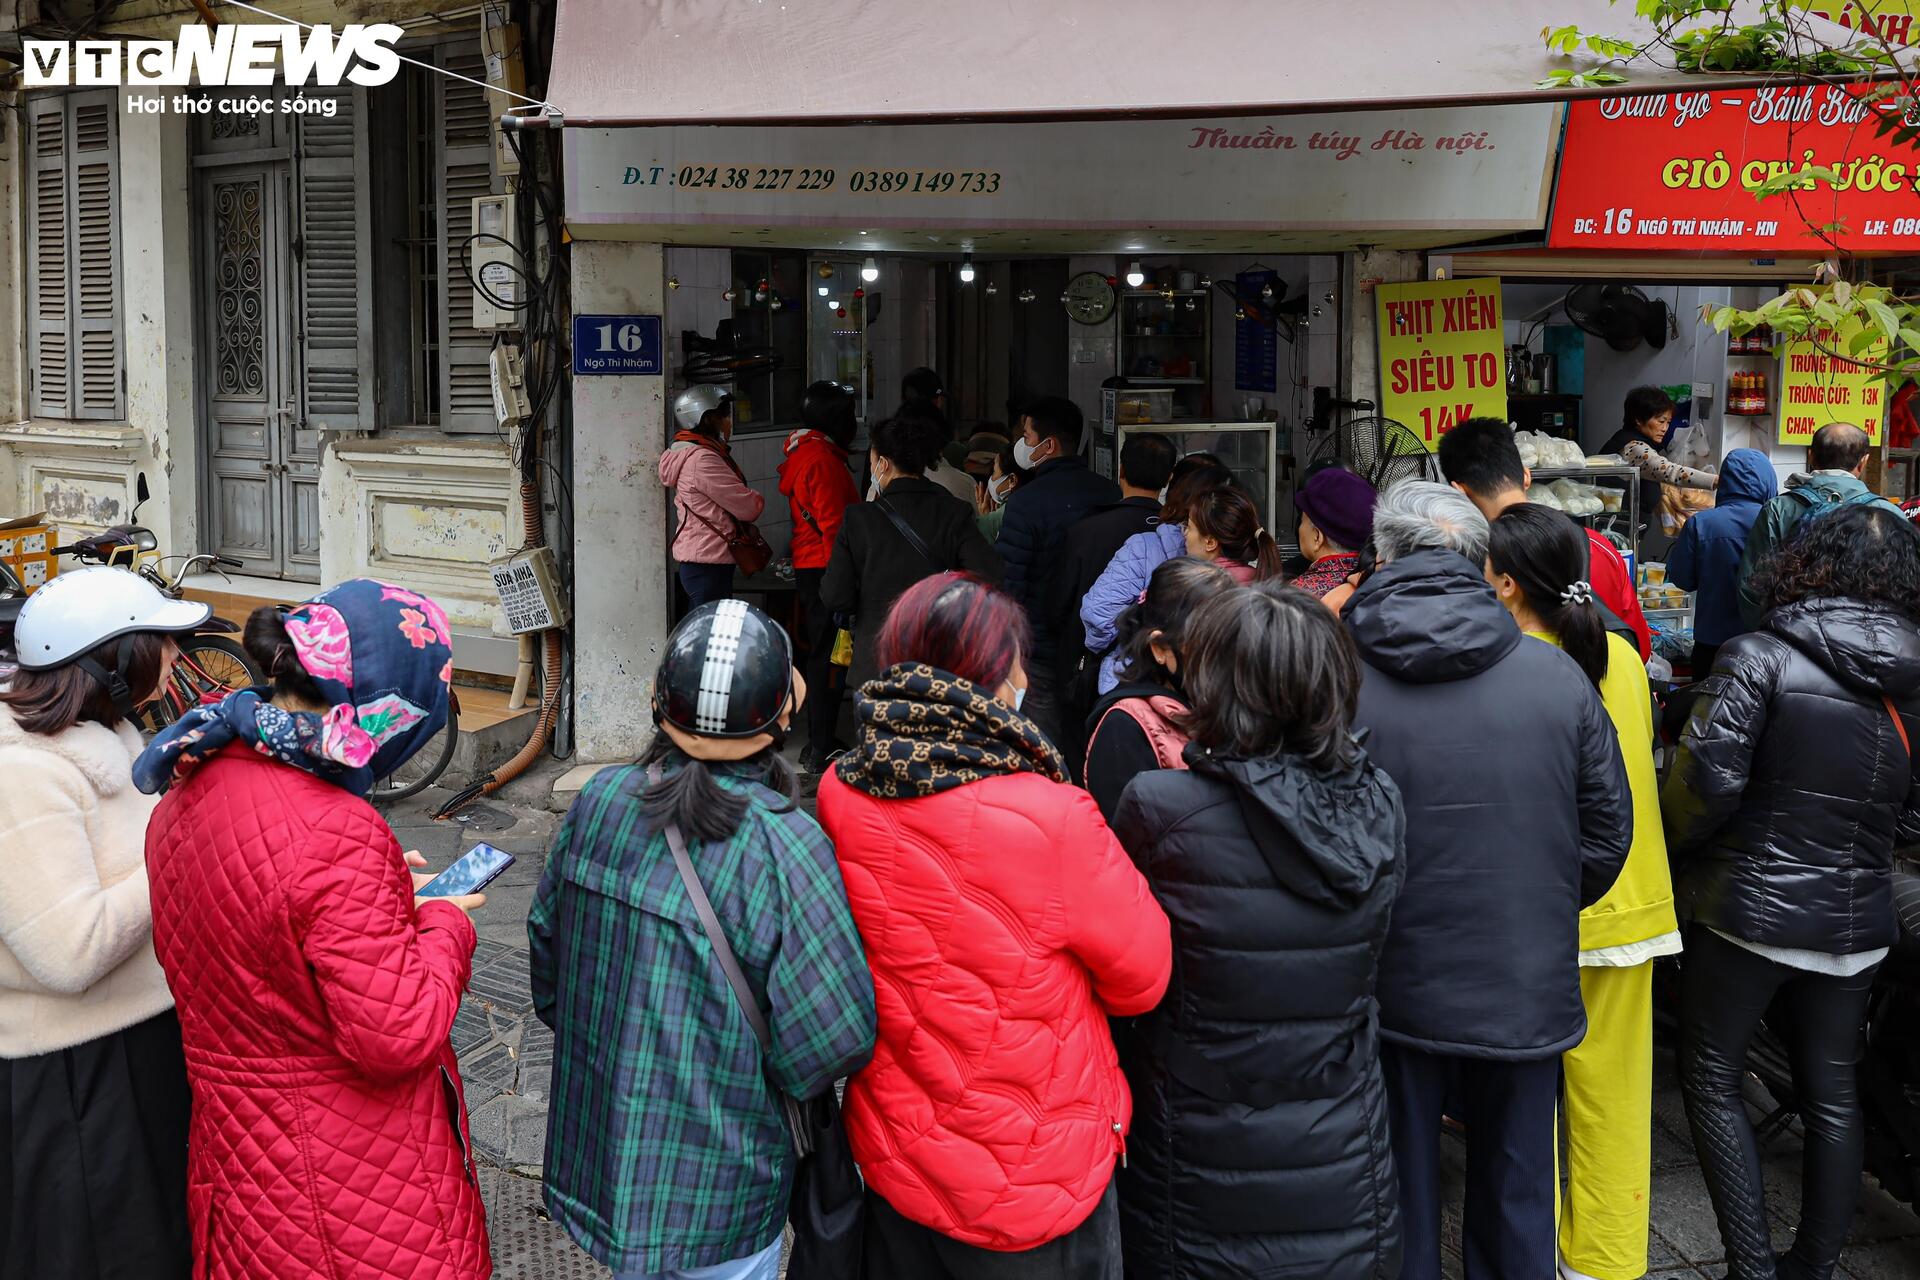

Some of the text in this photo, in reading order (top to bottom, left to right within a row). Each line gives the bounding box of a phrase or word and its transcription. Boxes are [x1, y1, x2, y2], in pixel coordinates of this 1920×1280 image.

[1811, 3, 1914, 46] ÁNH
[1188, 125, 1496, 161] Thuần túy Hà nội.
[721, 167, 750, 189] 38
[753, 168, 794, 190] 227
[796, 168, 835, 191] 229
[849, 171, 909, 193] 0389
[910, 171, 955, 193] 149
[959, 172, 1001, 194] 733
[1662, 151, 1731, 189] GIÒ
[1574, 218, 1598, 234] ĐC:
[1603, 207, 1633, 235] 16
[1637, 217, 1668, 236] NGÔ
[1671, 218, 1697, 236] THÌ
[1699, 217, 1744, 239] NHẬM
[1755, 221, 1778, 236] HN
[1863, 220, 1889, 235] LH:
[1385, 288, 1497, 343] THỊT XIÊN
[594, 323, 643, 353] 16
[584, 358, 605, 369] Ngô
[623, 358, 653, 369] Nhậm
[1390, 350, 1498, 395] SIÊU TO
[1788, 382, 1825, 405] TRỨNG
[1827, 383, 1851, 406] CÚT:
[1862, 388, 1880, 406] 13K
